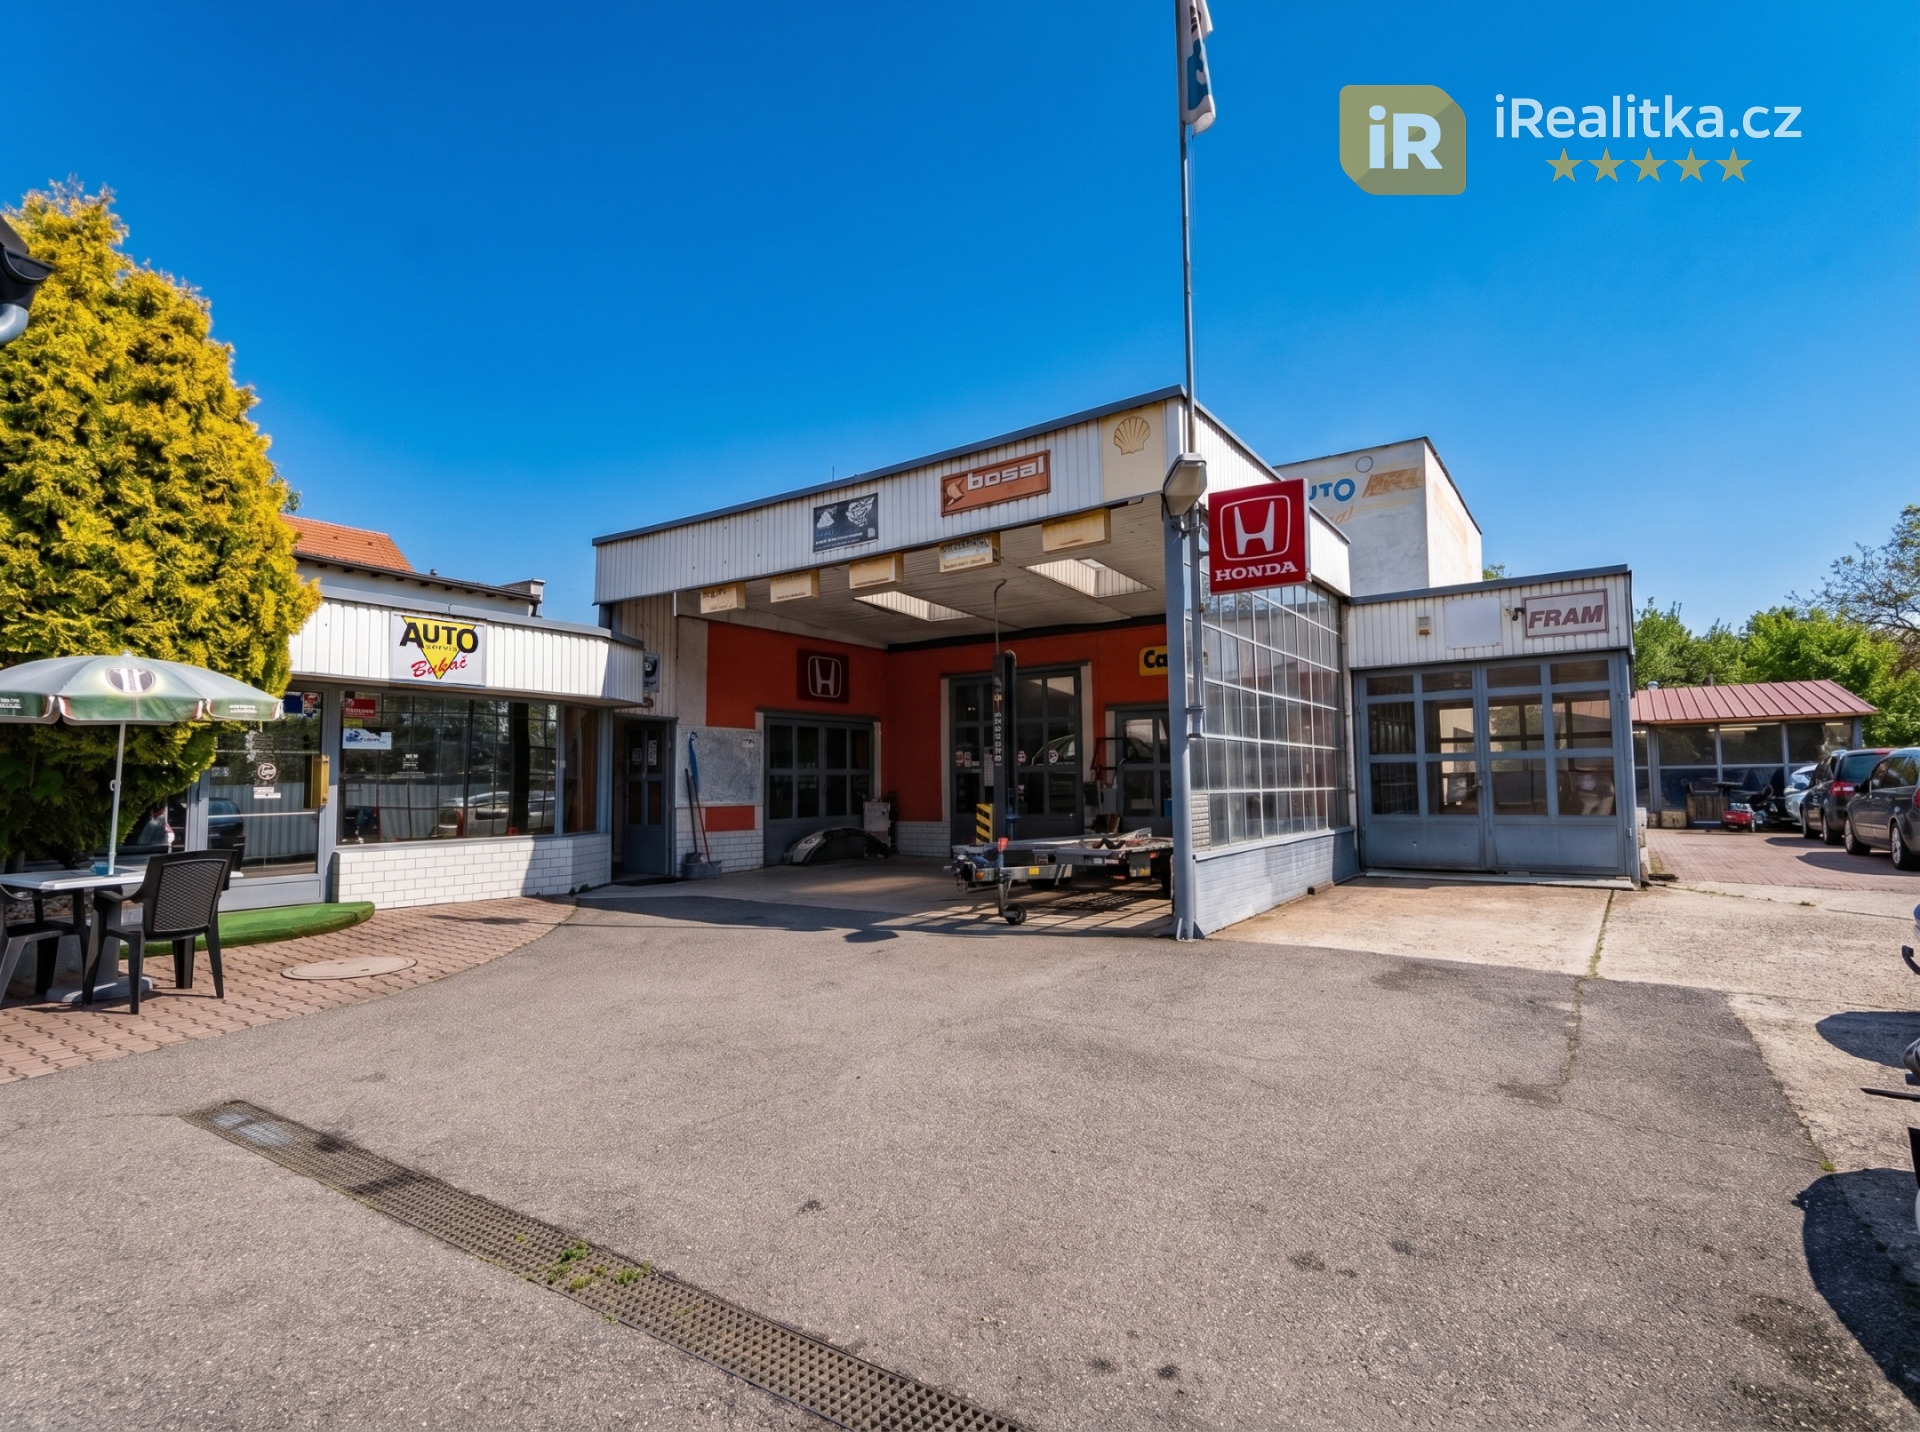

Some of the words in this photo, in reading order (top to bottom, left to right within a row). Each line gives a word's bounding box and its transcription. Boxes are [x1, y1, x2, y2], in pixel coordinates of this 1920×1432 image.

[967, 455, 1045, 491] bosal
[1215, 560, 1299, 582] HONDA
[1528, 604, 1604, 629] FRAM
[399, 622, 479, 654] AUTO
[425, 644, 458, 653] servis
[410, 655, 468, 678] Bukač
